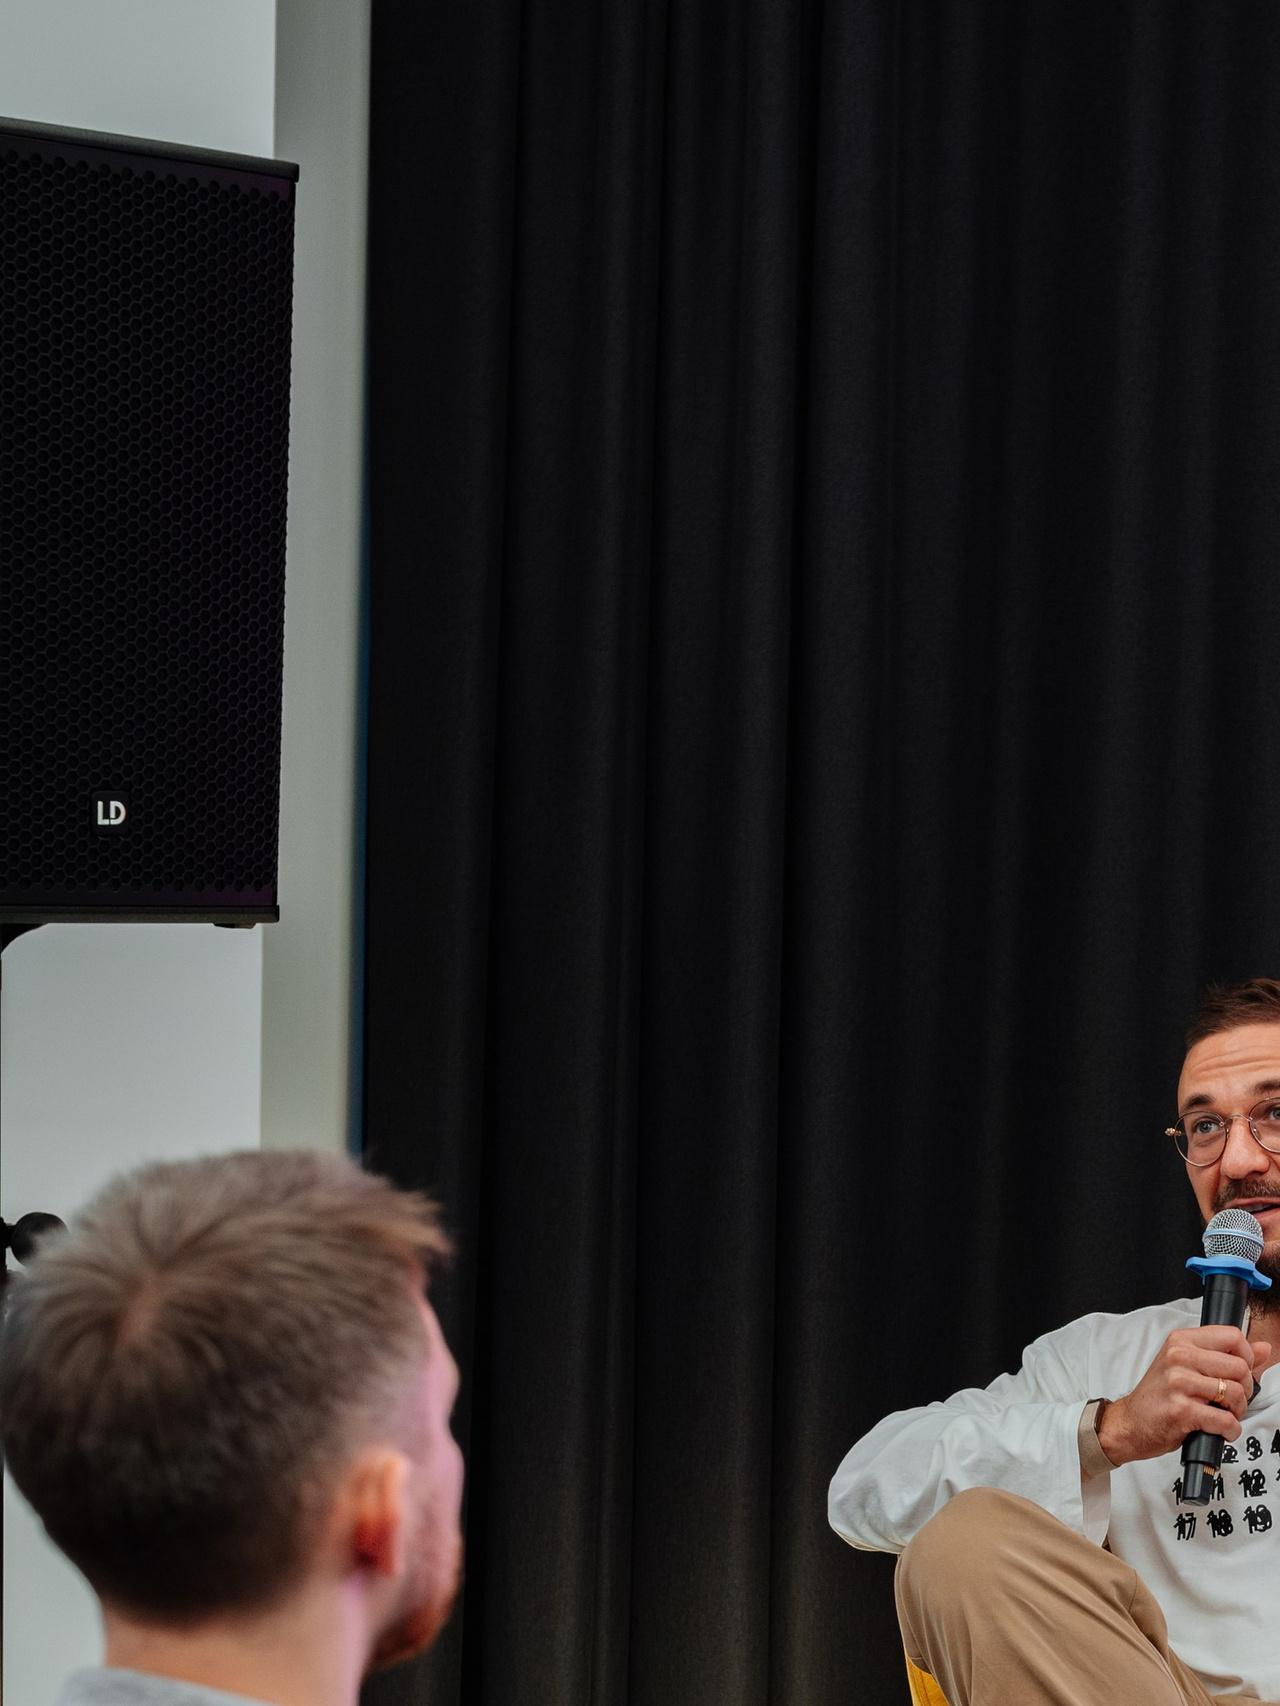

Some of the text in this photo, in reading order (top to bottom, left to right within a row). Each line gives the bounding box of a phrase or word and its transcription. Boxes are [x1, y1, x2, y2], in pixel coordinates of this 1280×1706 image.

[97, 800, 126, 825] LD
[1246, 1435, 1263, 1461] 3
[1238, 1468, 1267, 1498] 12
[1173, 1512, 1197, 1541] 17
[1206, 1508, 1234, 1539] 18
[1243, 1503, 1273, 1534] 19
